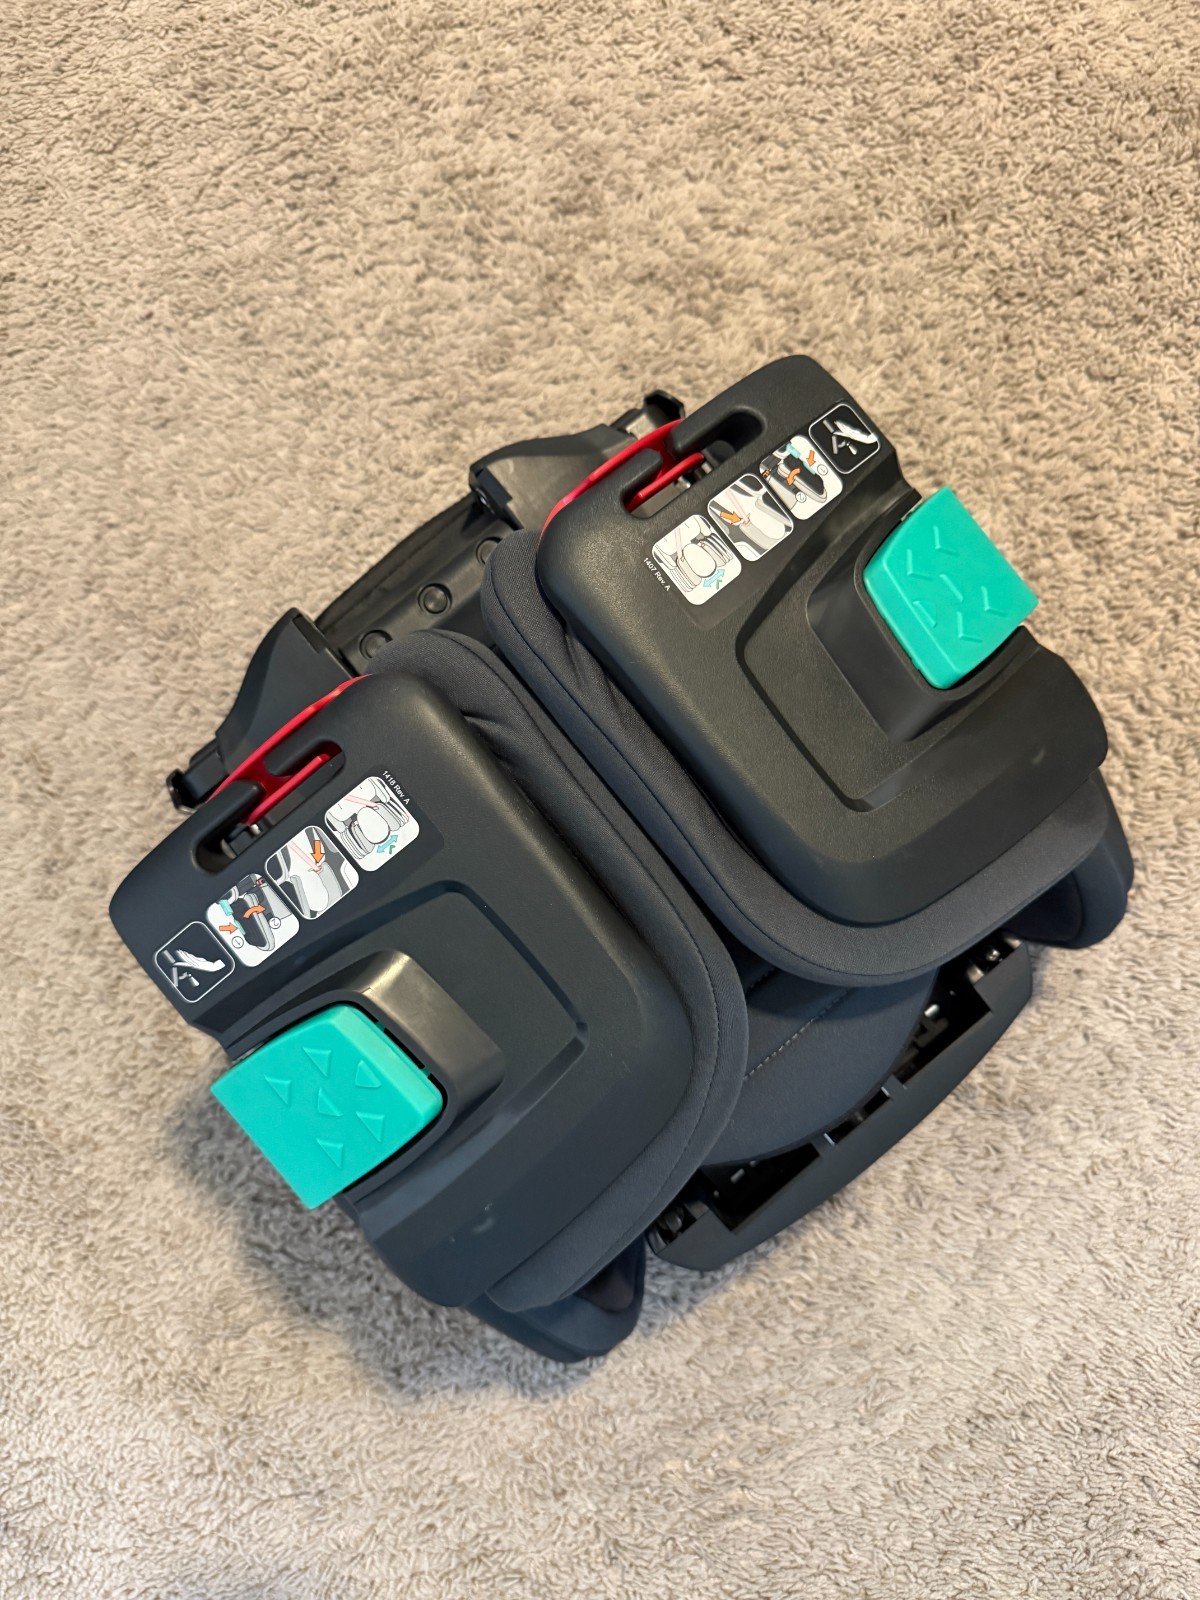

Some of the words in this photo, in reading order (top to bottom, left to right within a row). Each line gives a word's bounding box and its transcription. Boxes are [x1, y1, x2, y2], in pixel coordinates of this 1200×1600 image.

[643, 557, 657, 571] 1407
[654, 571, 666, 585] Rev.
[382, 770, 396, 786] 1418
[393, 784, 405, 799] Rev.
